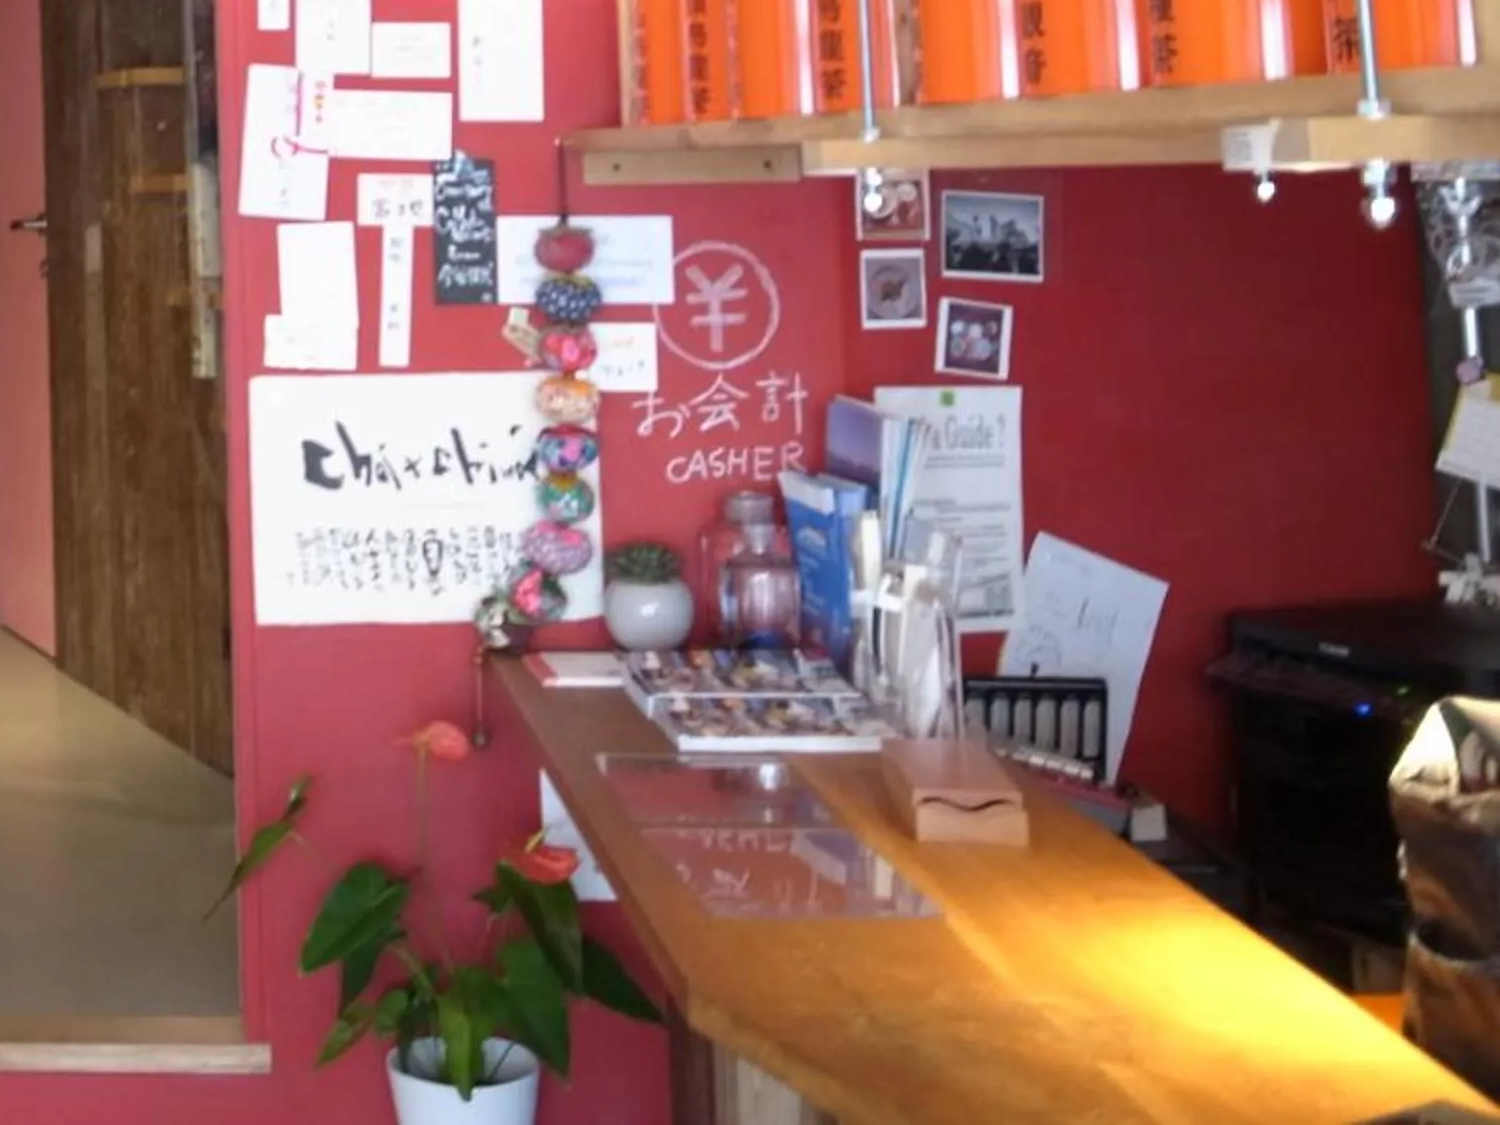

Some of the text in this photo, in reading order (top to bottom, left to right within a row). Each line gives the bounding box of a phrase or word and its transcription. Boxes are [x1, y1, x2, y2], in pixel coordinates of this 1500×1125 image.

[632, 371, 808, 439] お会計
[666, 440, 806, 483] CASHER
